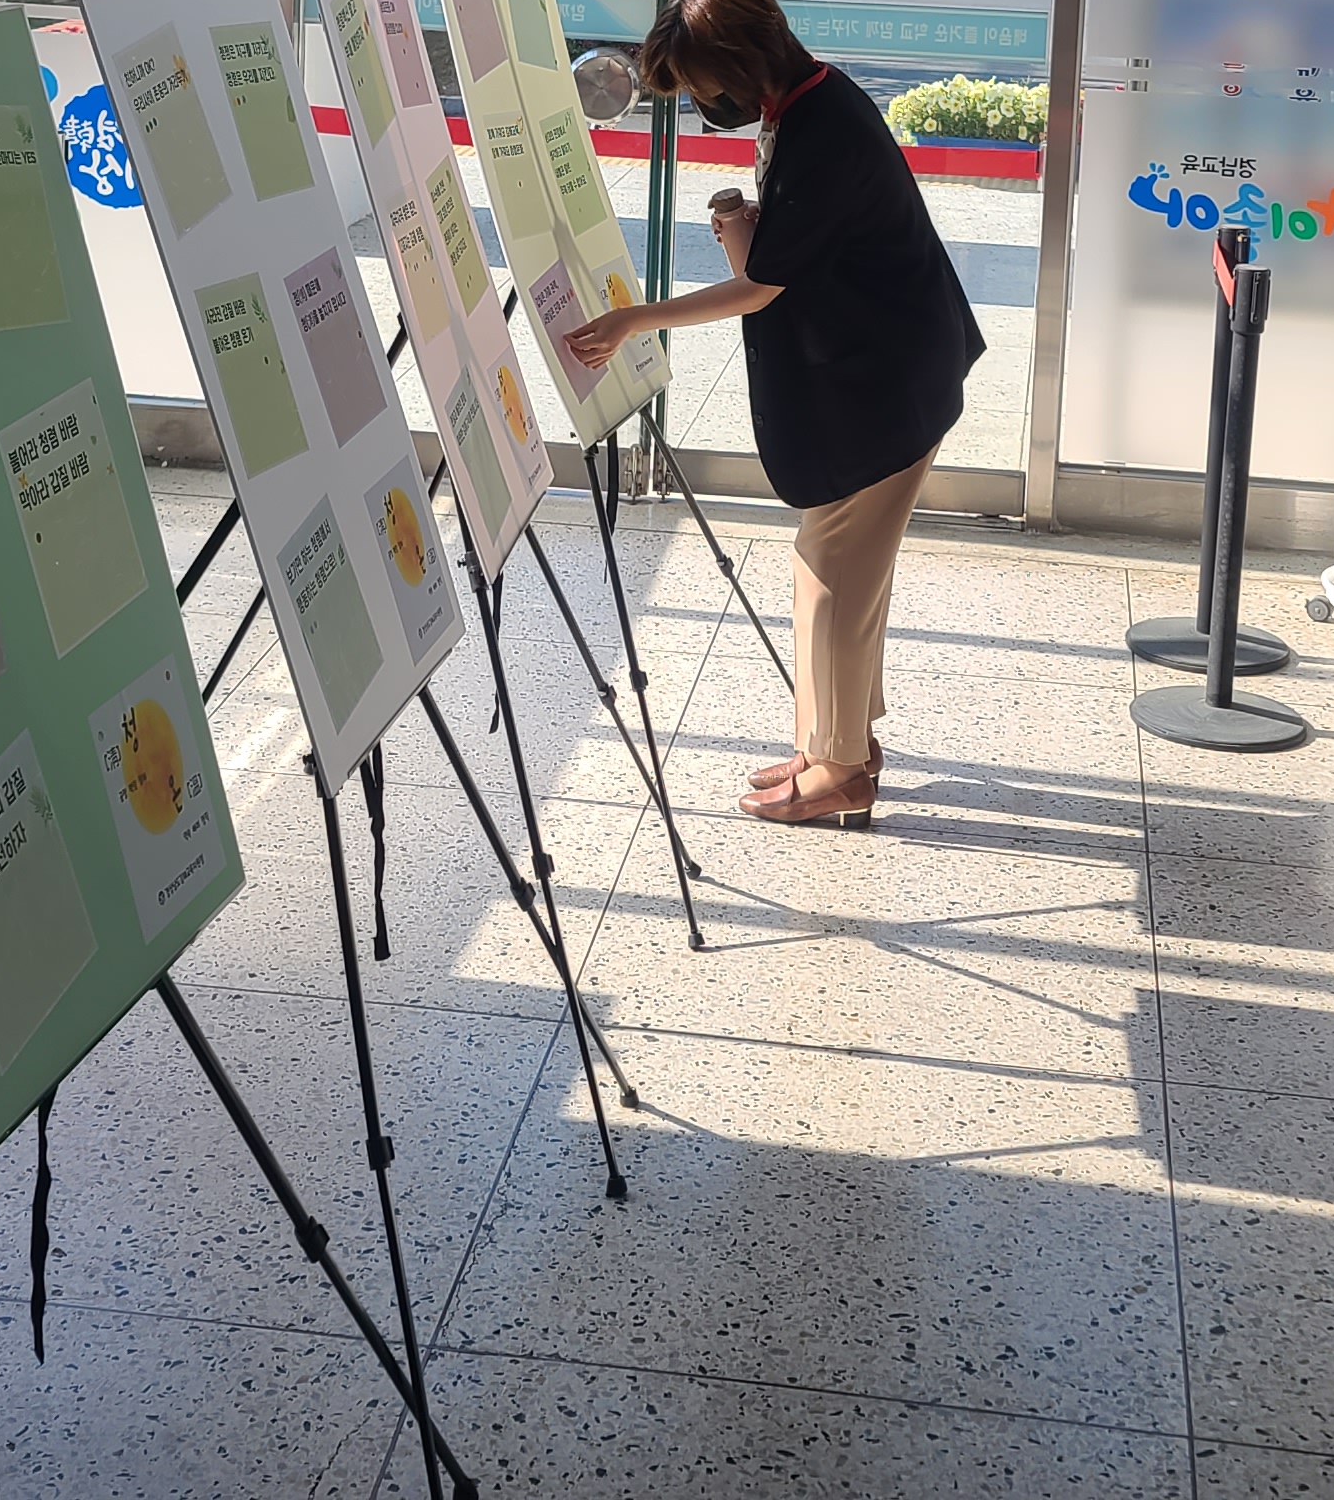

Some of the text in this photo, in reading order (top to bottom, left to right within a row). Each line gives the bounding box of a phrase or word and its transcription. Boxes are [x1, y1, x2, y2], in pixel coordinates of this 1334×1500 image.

[235, 42, 252, 58] 지구를
[124, 62, 145, 88] 친하니까
[225, 70, 242, 87] 청렴은
[241, 68, 259, 85] 우리를
[153, 80, 169, 103] 존중의
[23, 151, 37, 164] YES
[205, 306, 223, 325] 사라진
[222, 303, 235, 320] 갑질
[230, 330, 243, 349] 청렴
[241, 326, 254, 344] 온기
[7, 413, 81, 474] 불어라 청렴 바람
[19, 451, 90, 512] 막아라 갑질 바람
[285, 518, 331, 585] 보기만 하는 청렴에서
[121, 707, 139, 753] 청
[1, 767, 28, 807] 갑질
[168, 774, 184, 814] 온
